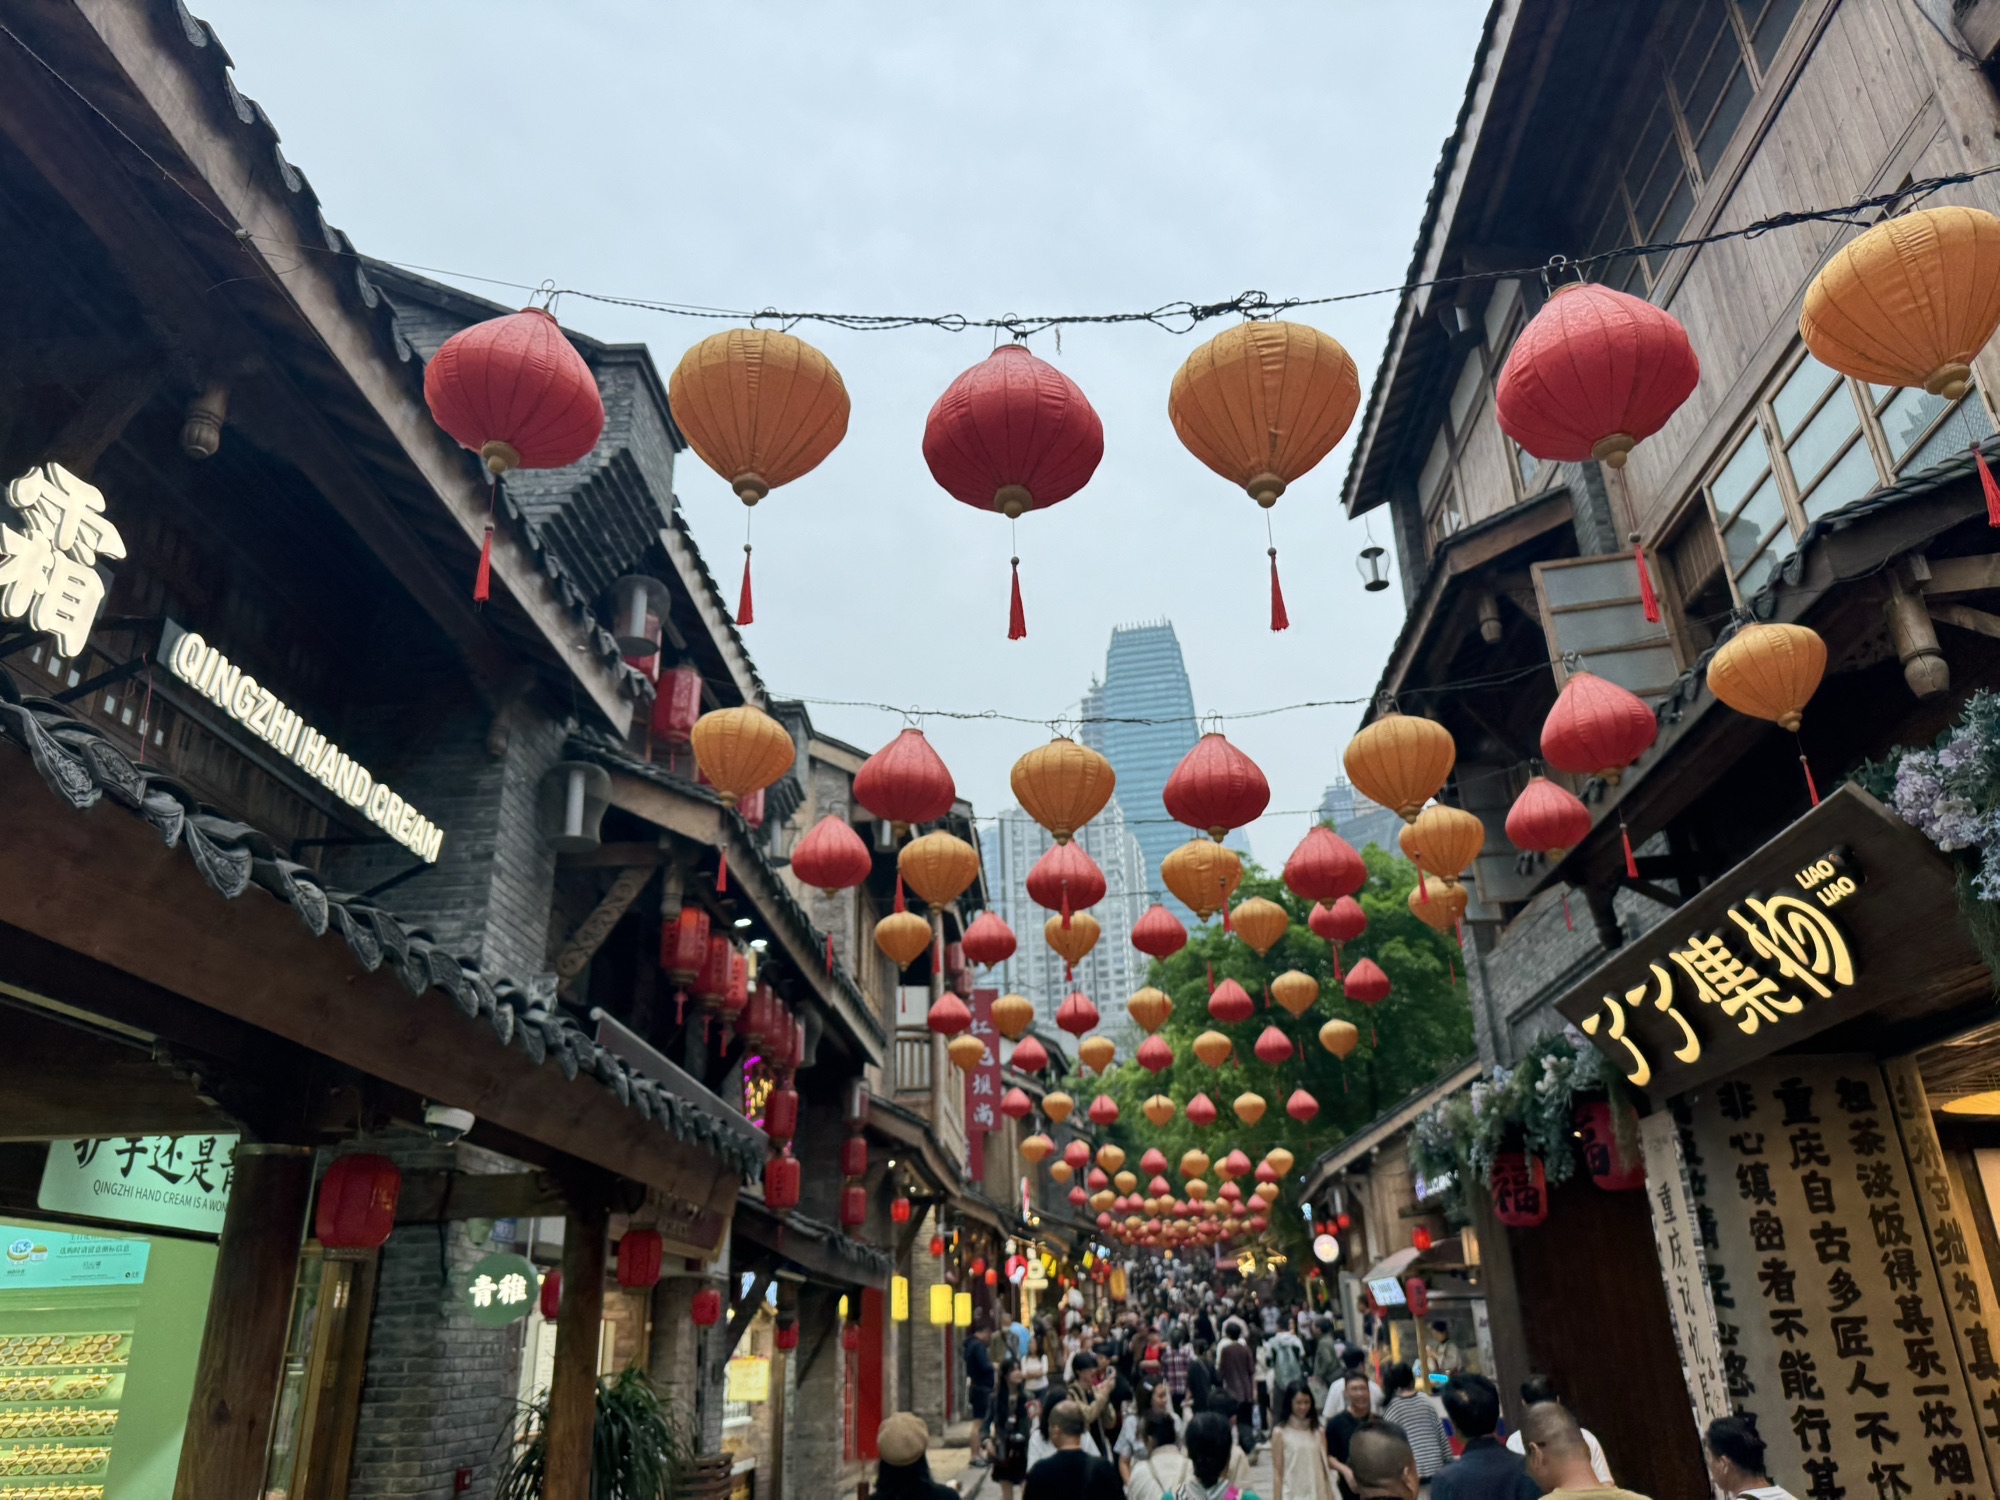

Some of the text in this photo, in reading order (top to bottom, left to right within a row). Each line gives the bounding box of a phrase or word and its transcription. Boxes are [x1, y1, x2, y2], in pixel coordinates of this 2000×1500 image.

[0, 462, 127, 658] 霜
[169, 632, 444, 863] QINGZHI HAND CREAM
[1795, 859, 1835, 890] LIAO
[1816, 876, 1857, 907] LIAO
[93, 1179, 134, 1197] QINGZHI
[135, 1187, 162, 1202] HAND
[163, 1190, 192, 1208] CREAM
[193, 1196, 201, 1209] IS
[202, 1198, 208, 1210] A
[469, 1273, 527, 1307] 青稚
[1835, 1076, 1976, 1500] 粗茶淡饭得其乐一炊烟
